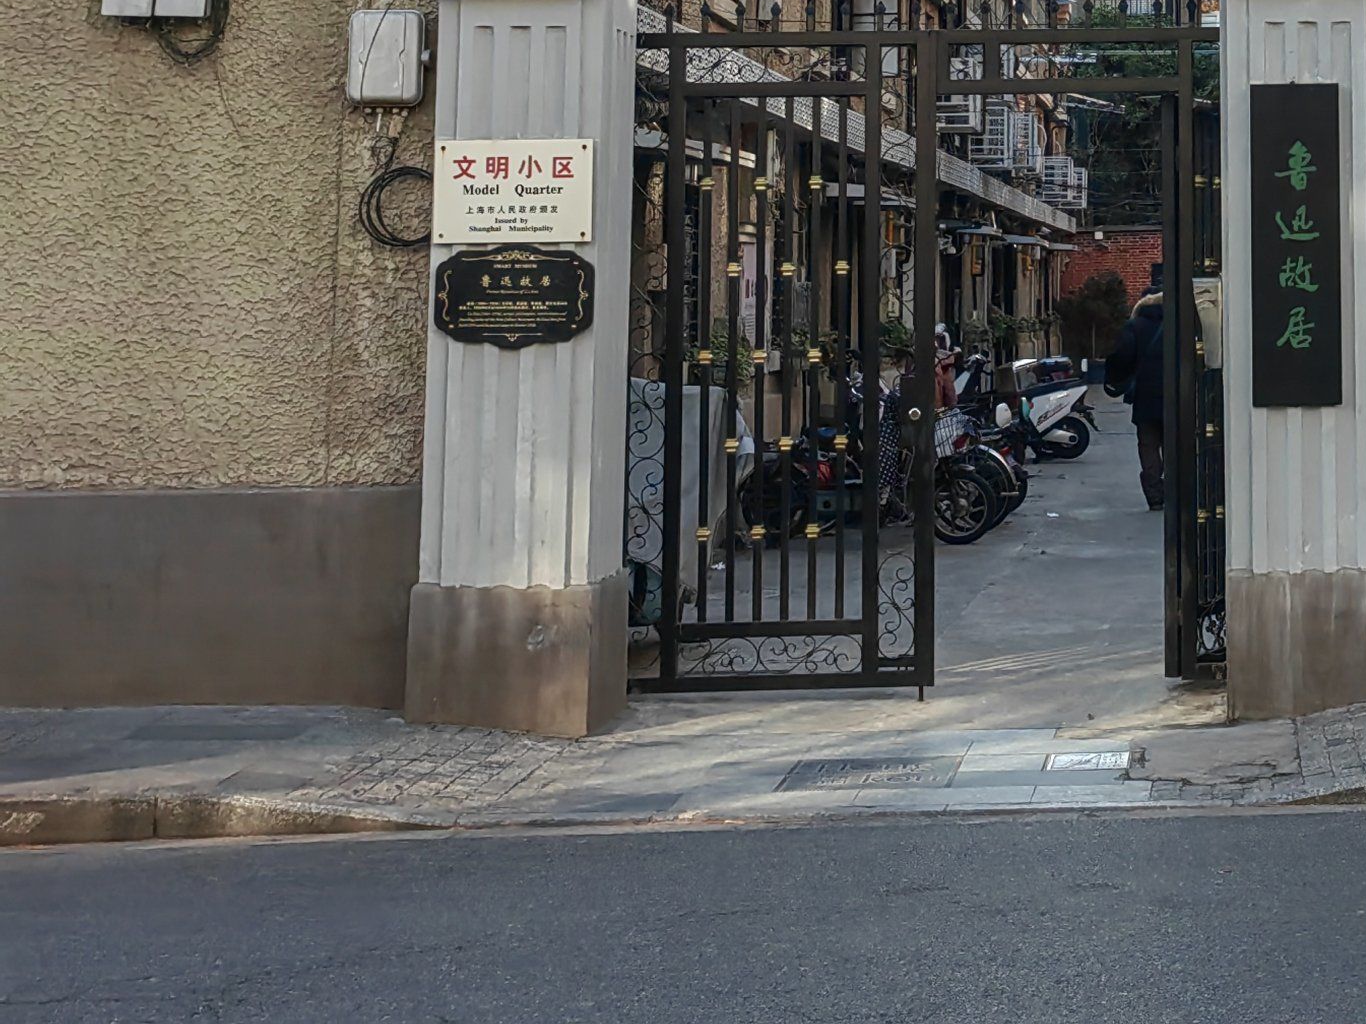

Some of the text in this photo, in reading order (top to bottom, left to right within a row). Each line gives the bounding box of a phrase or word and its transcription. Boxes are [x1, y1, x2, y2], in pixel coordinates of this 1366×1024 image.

[453, 155, 574, 179] 文明小区
[463, 183, 563, 197] Model Quarter
[465, 205, 559, 214] 上海市人民政府颁发
[520, 217, 528, 226] by
[469, 224, 554, 233] Shanghai Municipality
